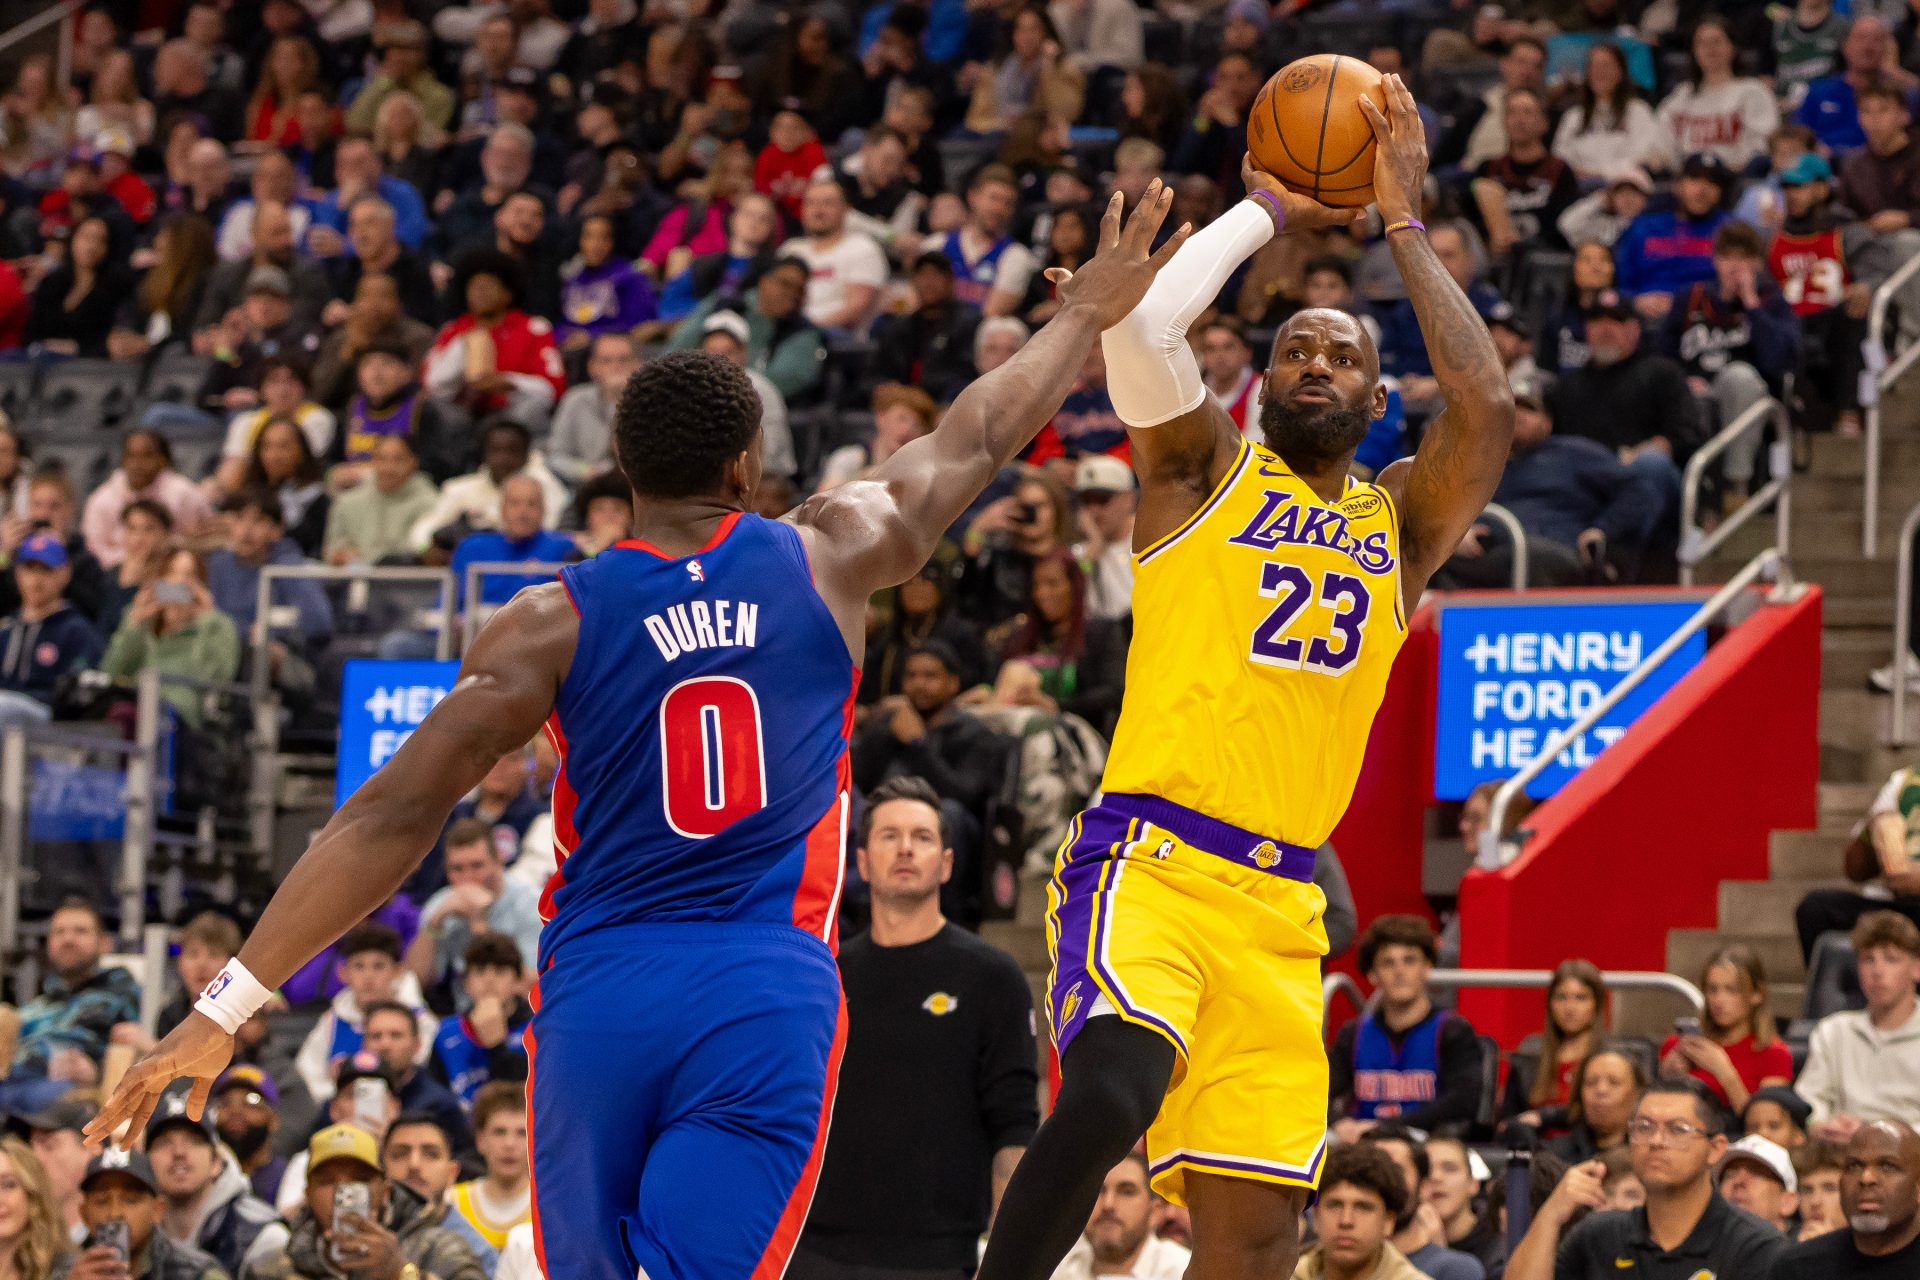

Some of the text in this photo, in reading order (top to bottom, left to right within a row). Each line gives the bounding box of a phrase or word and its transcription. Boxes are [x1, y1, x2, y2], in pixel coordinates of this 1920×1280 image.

[1226, 489, 1395, 575] LAKERS
[643, 599, 759, 662] DUREN
[1249, 559, 1372, 678] 23
[1464, 630, 1643, 673] HENRY
[1472, 679, 1603, 721] FORD
[659, 675, 768, 840] 0
[1471, 726, 1628, 768] HEALT
